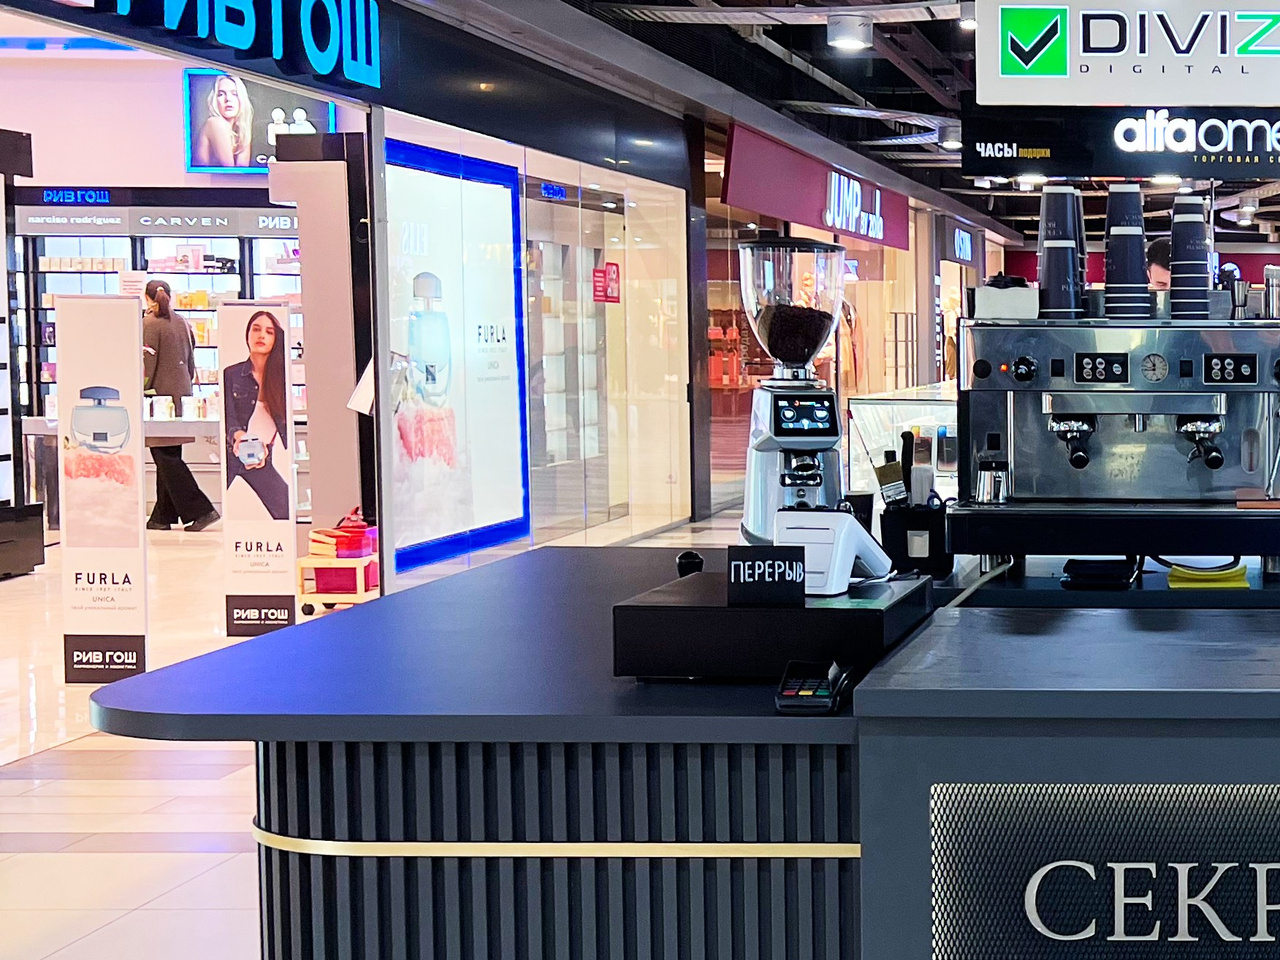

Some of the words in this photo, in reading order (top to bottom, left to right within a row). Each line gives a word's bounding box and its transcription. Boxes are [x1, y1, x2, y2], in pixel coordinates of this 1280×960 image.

[1079, 64, 1249, 74] DIGITAL
[976, 142, 1017, 158] ЧАСЫ
[1018, 148, 1050, 159] подарки
[1193, 155, 1260, 163] ТОРГОВАЯ
[825, 171, 861, 232] JUMP
[28, 216, 68, 224] narciso
[70, 215, 121, 225] rodriguez
[139, 217, 229, 226] CARVEN
[258, 216, 291, 229] РИВ
[478, 325, 507, 343] FURLA
[235, 542, 283, 552] FURLA
[730, 561, 805, 584] ПЕРЕРЫВ
[75, 573, 131, 584] FURLA
[234, 608, 259, 619] РИВ
[261, 608, 288, 619] ГОШ
[73, 651, 103, 663] РИВ
[105, 651, 136, 663] ГОШ
